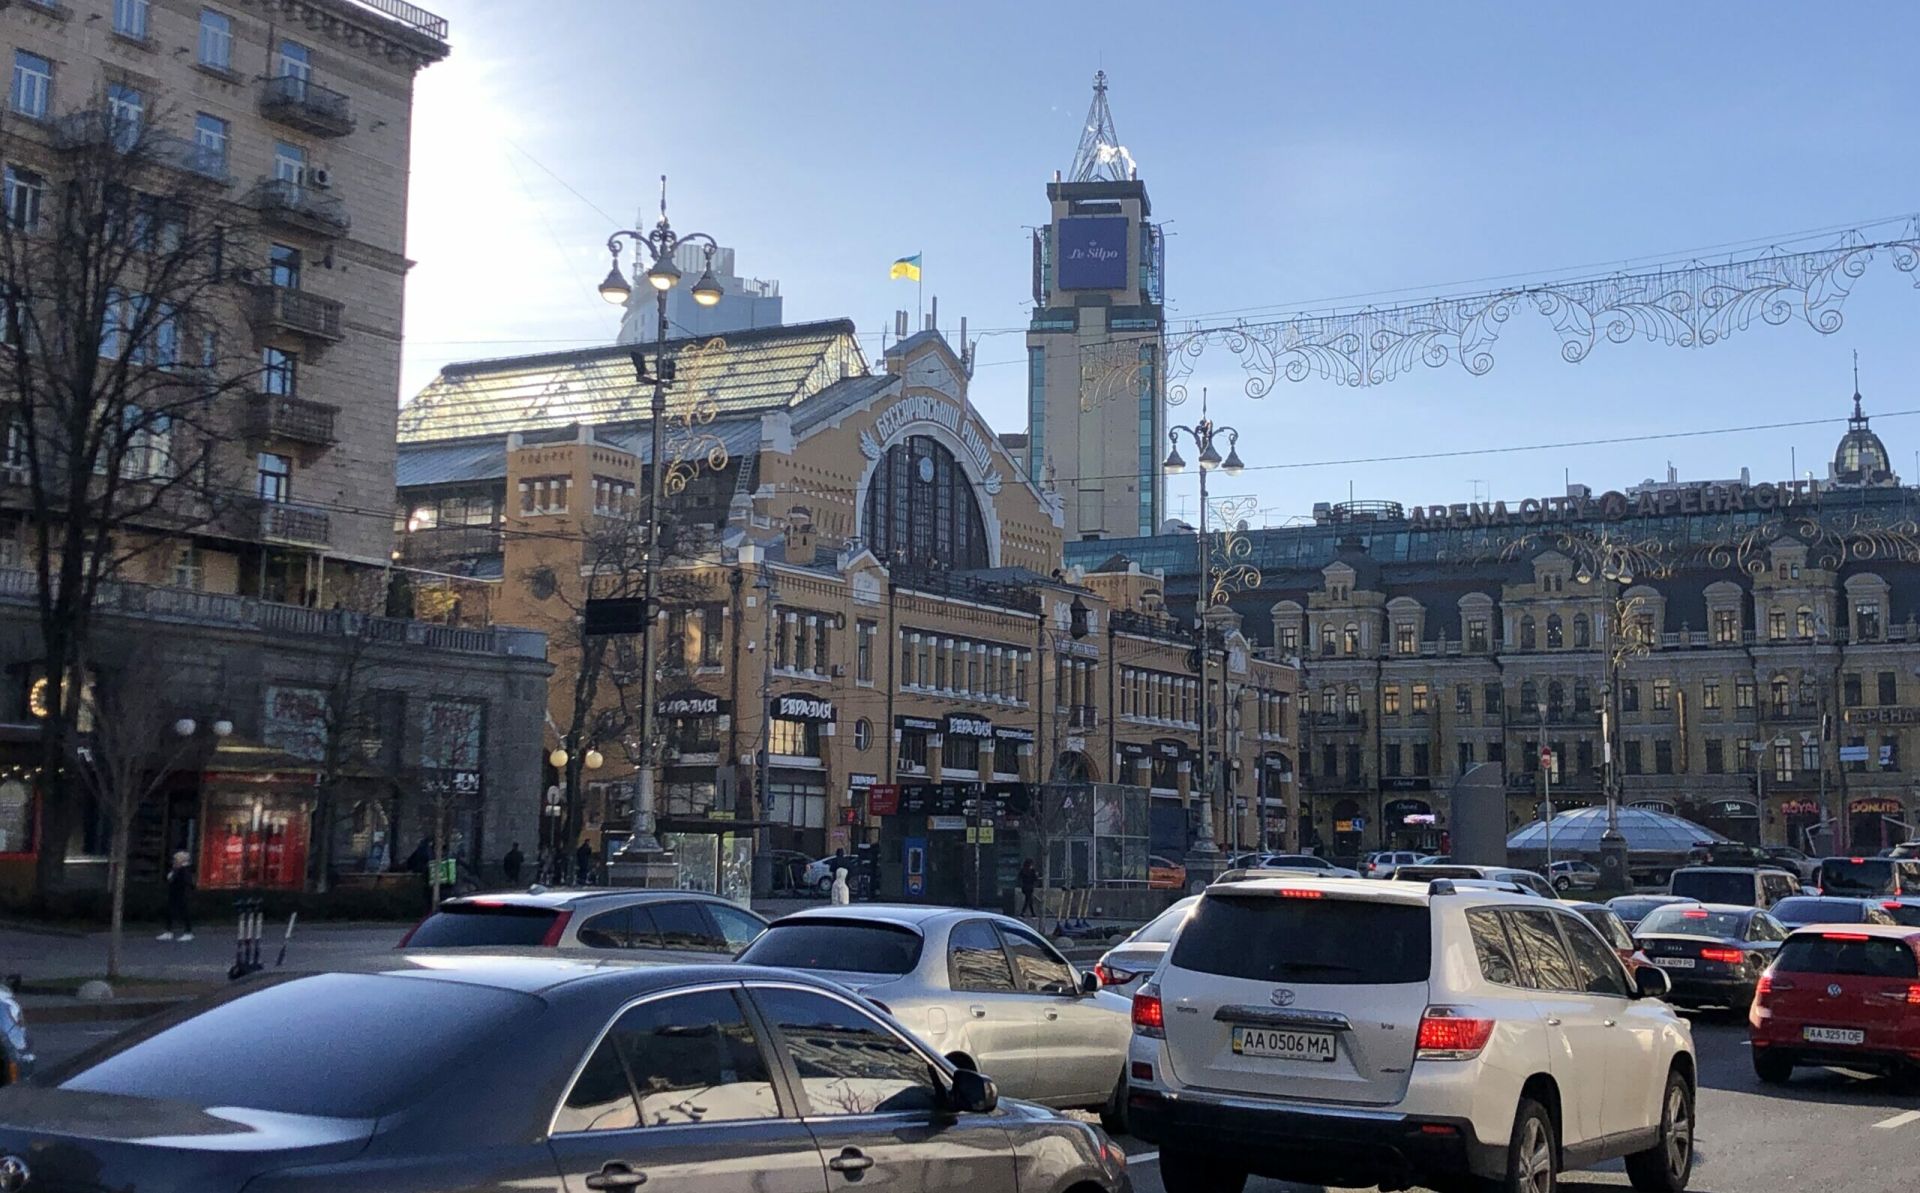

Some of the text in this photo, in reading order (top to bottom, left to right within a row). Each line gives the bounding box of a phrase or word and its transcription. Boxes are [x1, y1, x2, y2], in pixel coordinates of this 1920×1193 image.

[1086, 247, 1118, 261] Silpo
[876, 396, 992, 473] БЕССАРАБСЬКИЙ РИНОК
[1638, 482, 1744, 515] АРЕНА
[1409, 494, 1590, 530] ARENA CITY
[780, 698, 832, 719] ЕВРАЗИЯ
[950, 717, 992, 737] ЕВРАЗИЯ
[1782, 801, 1819, 814] ROYAL
[1851, 802, 1899, 813] DONUTS
[1244, 1031, 1330, 1054] AA 0506 MA
[1810, 1028, 1823, 1038] AA
[1824, 1030, 1846, 1040] 3251
